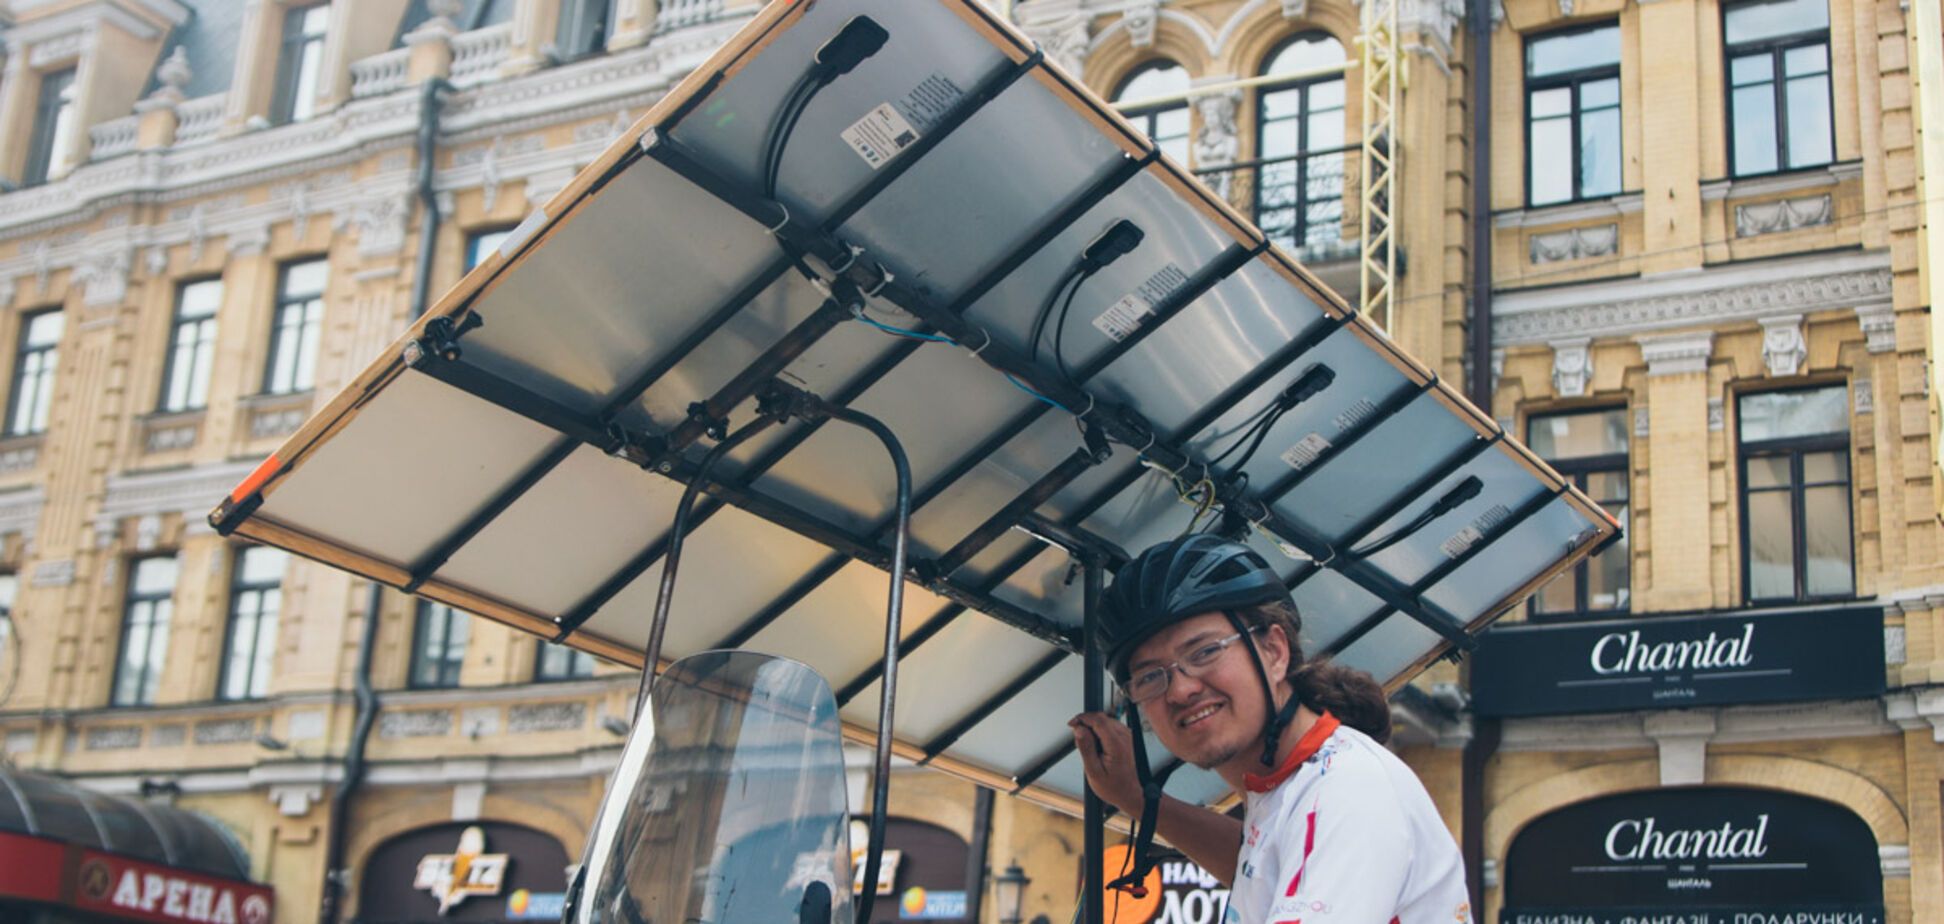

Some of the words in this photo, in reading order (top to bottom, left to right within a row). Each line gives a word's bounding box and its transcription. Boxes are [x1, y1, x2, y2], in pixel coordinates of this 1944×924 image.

[1591, 623, 1754, 675] Chantal
[1604, 813, 1769, 861] Chantal
[111, 868, 236, 924] АРЕНА
